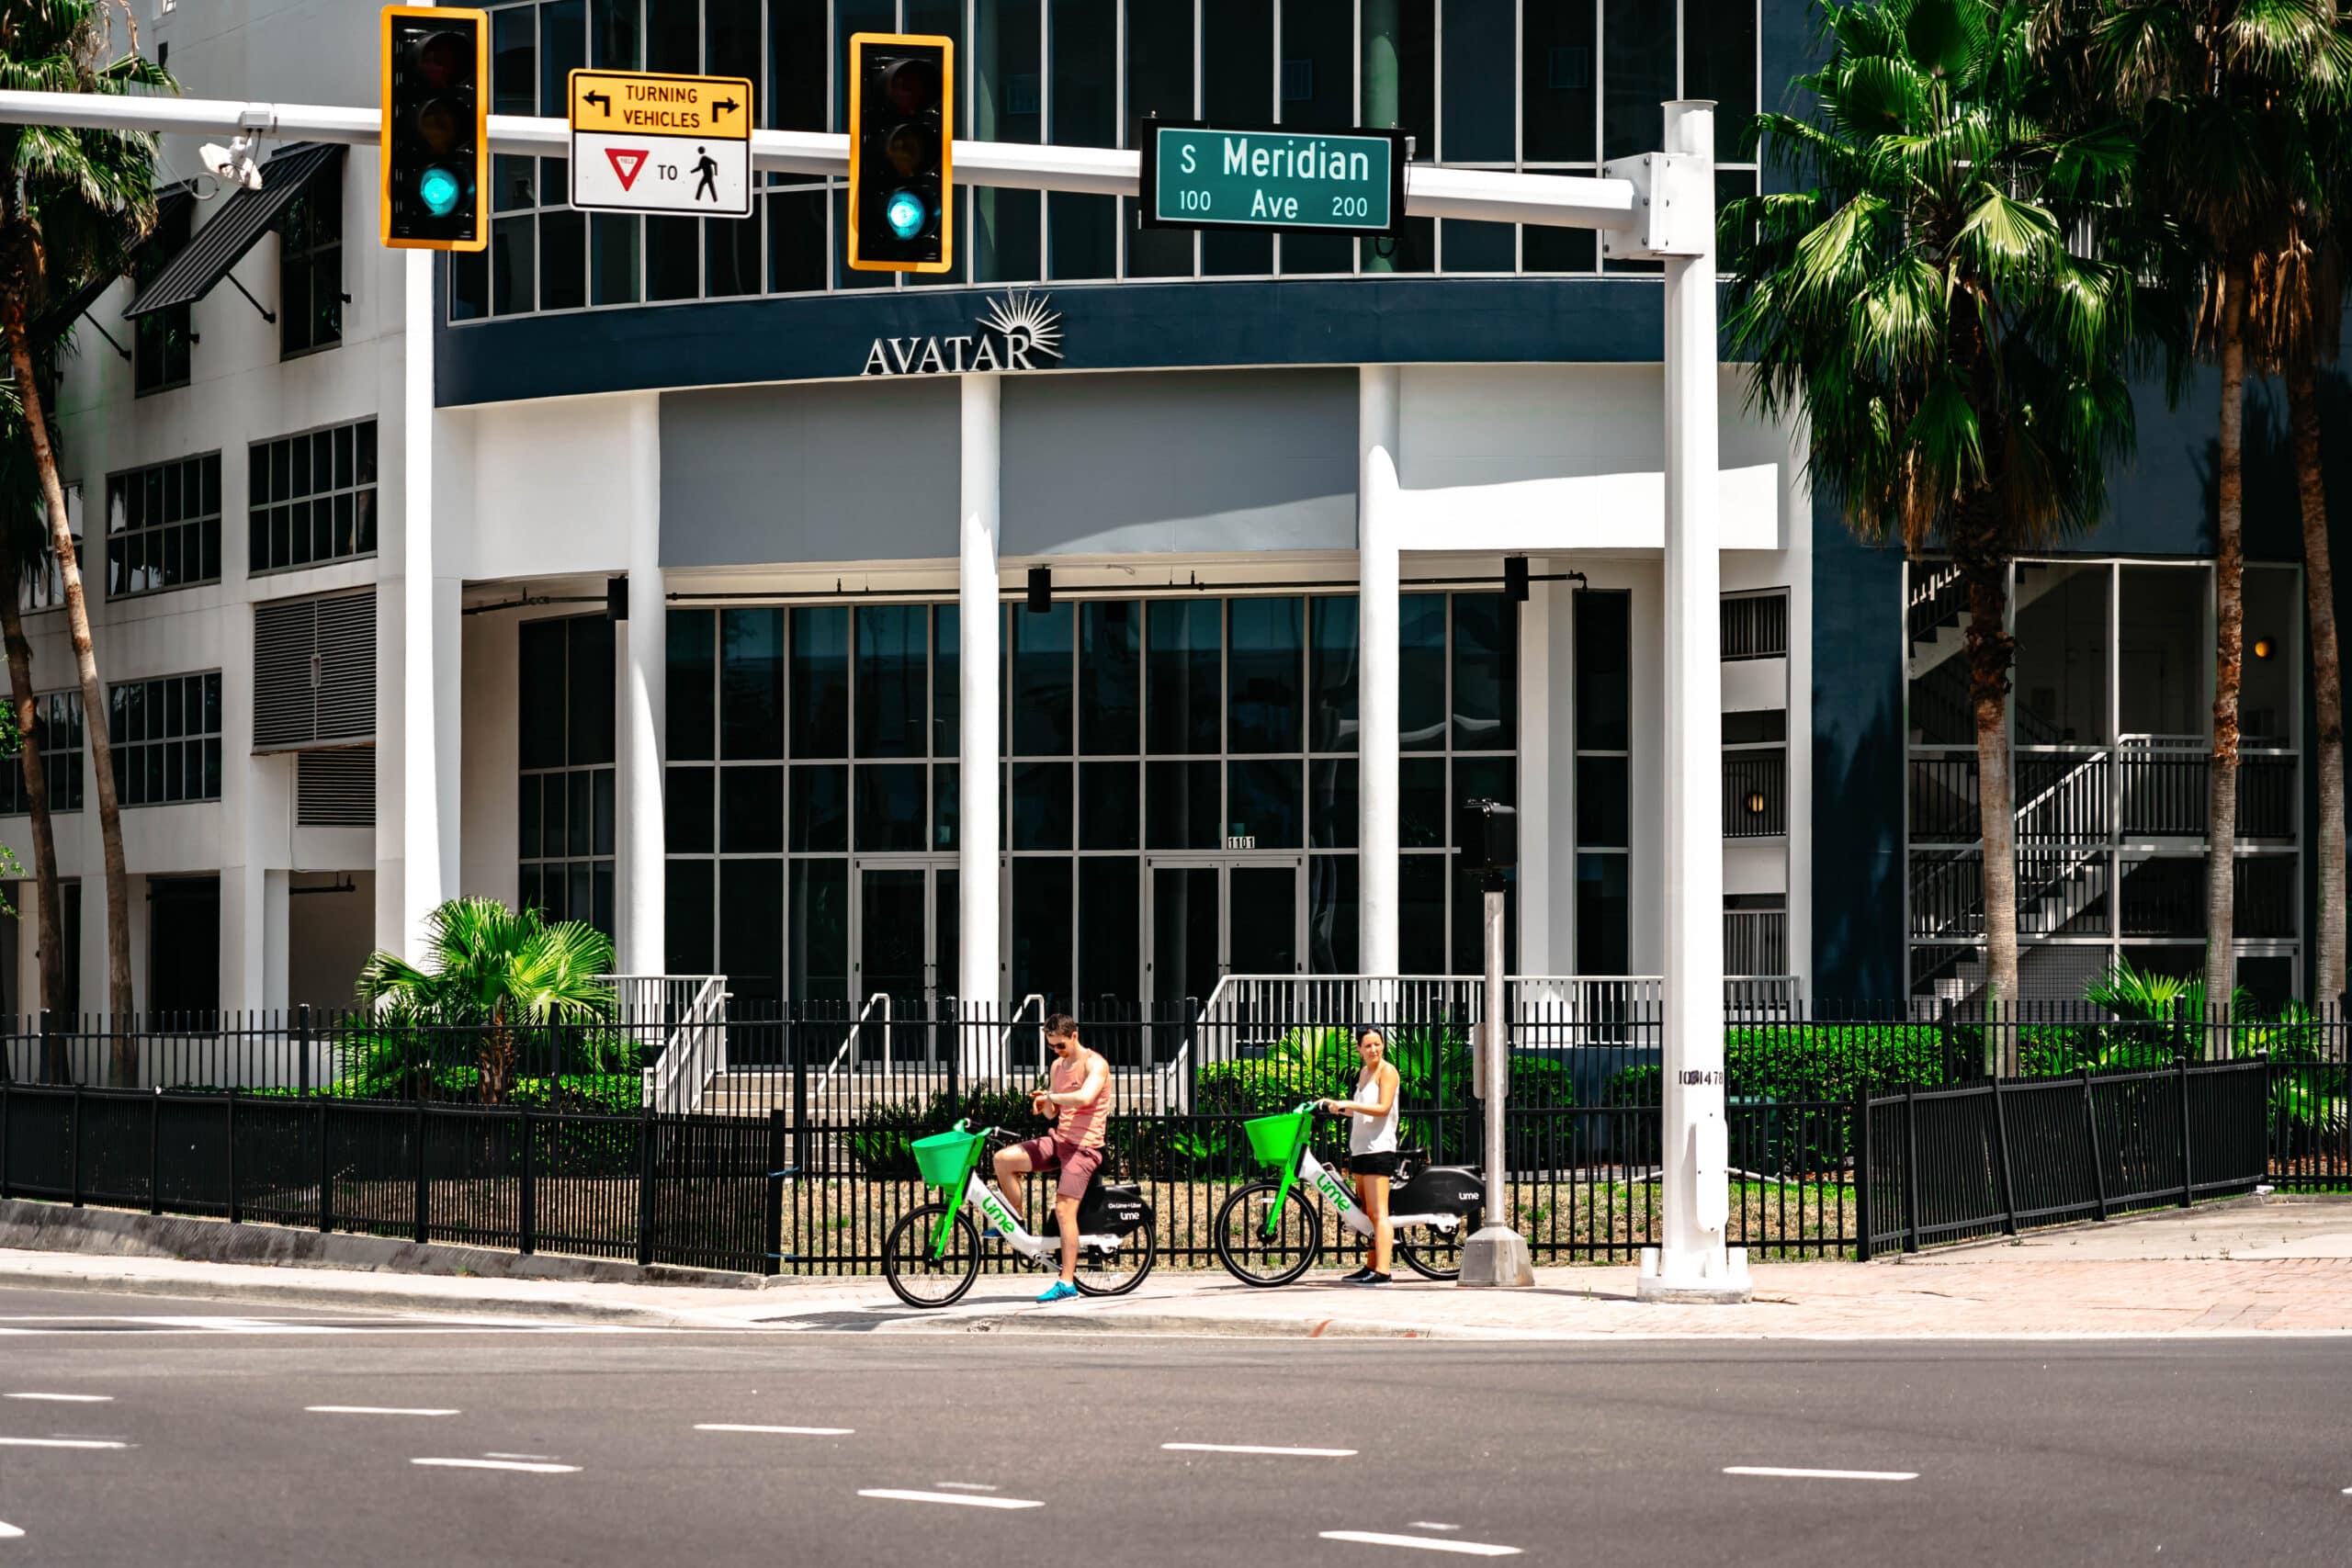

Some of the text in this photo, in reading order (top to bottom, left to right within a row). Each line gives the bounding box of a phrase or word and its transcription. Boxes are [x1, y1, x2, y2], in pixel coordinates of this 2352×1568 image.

[625, 85, 698, 104] TURNING
[623, 109, 700, 129] VEHICLES
[657, 164, 678, 181] TO
[1181, 137, 1368, 181] S Meridian
[1180, 188, 1368, 220] 100 Ave 200
[860, 333, 1037, 377] AVATAR
[1228, 837, 1255, 849] 1101
[1316, 1173, 1351, 1212] Lime
[982, 1197, 1015, 1235] Lime
